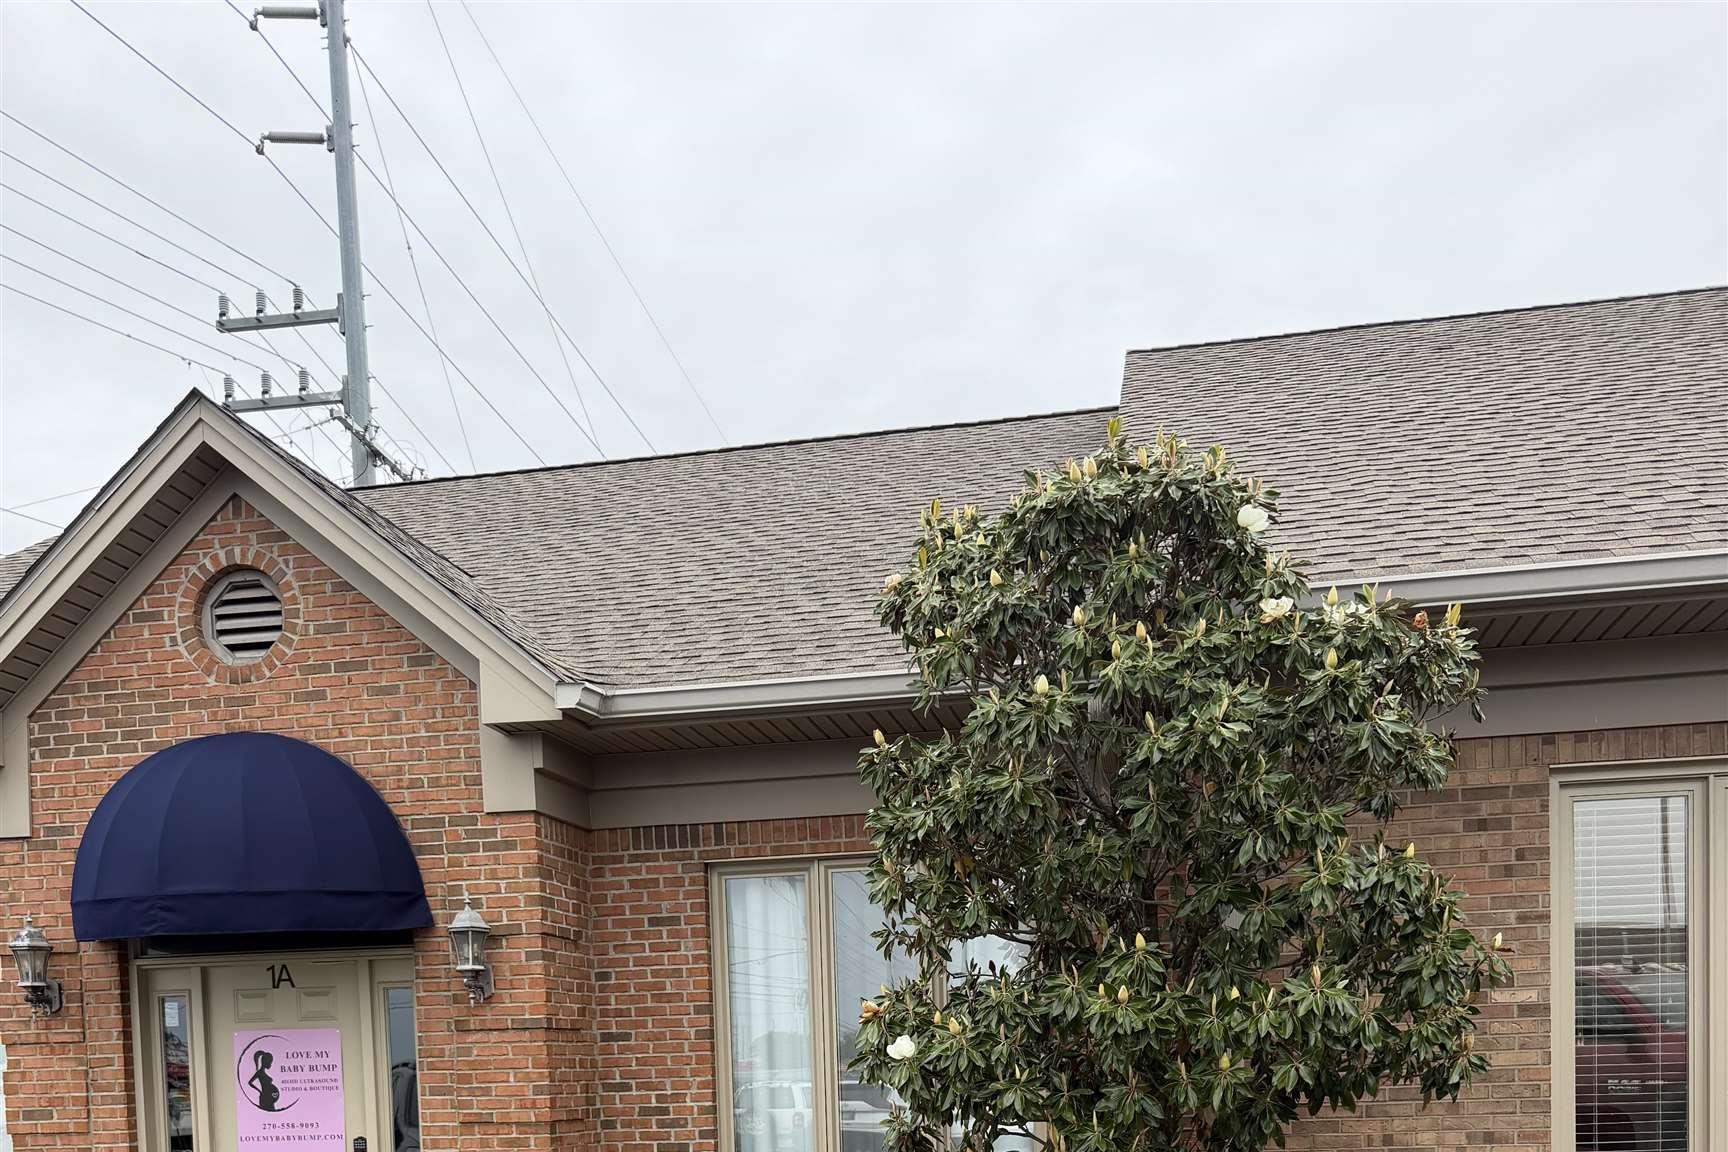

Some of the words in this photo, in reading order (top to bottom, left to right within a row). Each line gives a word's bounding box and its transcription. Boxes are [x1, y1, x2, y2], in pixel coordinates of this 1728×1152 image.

[266, 964, 296, 989] 1A
[285, 1050, 312, 1059] LOVE
[315, 1050, 330, 1059] MY
[280, 1064, 305, 1073] BABY
[308, 1063, 338, 1072] BUMP
[240, 1134, 343, 1142] LOVEMYBABYBUMP.COM
